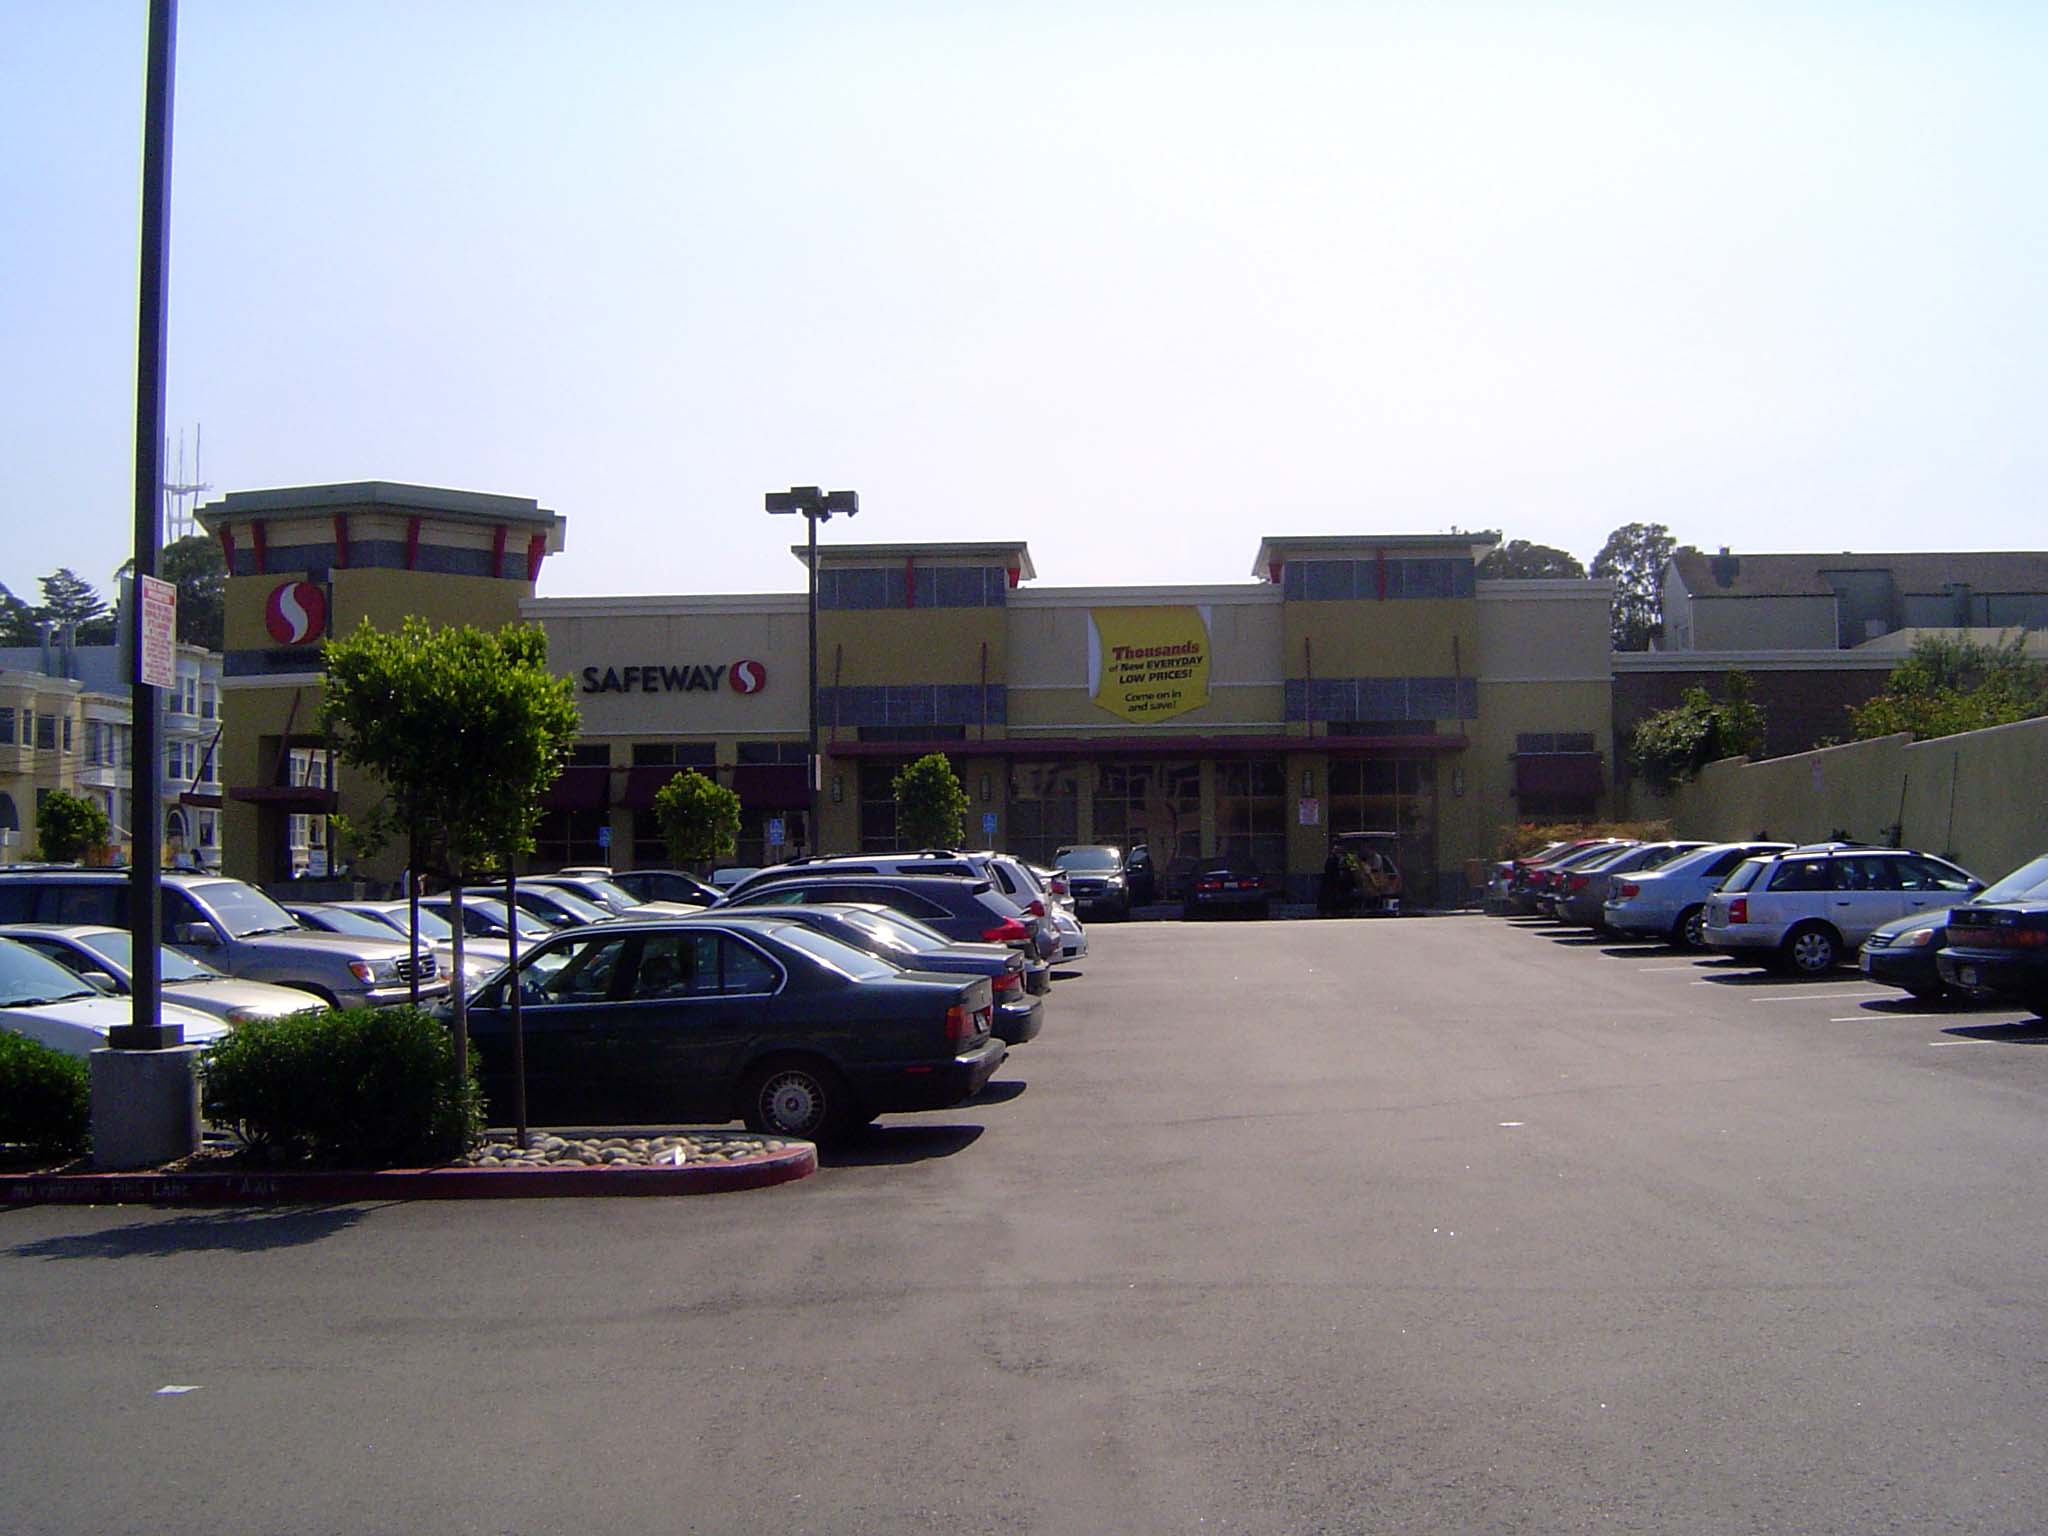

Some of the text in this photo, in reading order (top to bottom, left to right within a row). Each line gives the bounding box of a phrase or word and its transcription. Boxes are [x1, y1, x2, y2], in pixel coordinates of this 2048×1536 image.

[1112, 641, 1200, 660] Thousands
[1108, 656, 1203, 672] of New EVERYDAY
[582, 664, 726, 693] SAFEWAY
[1119, 669, 1192, 684] LOW PRICES!
[1125, 688, 1182, 701] Come on in
[1128, 701, 1176, 713] and save!
